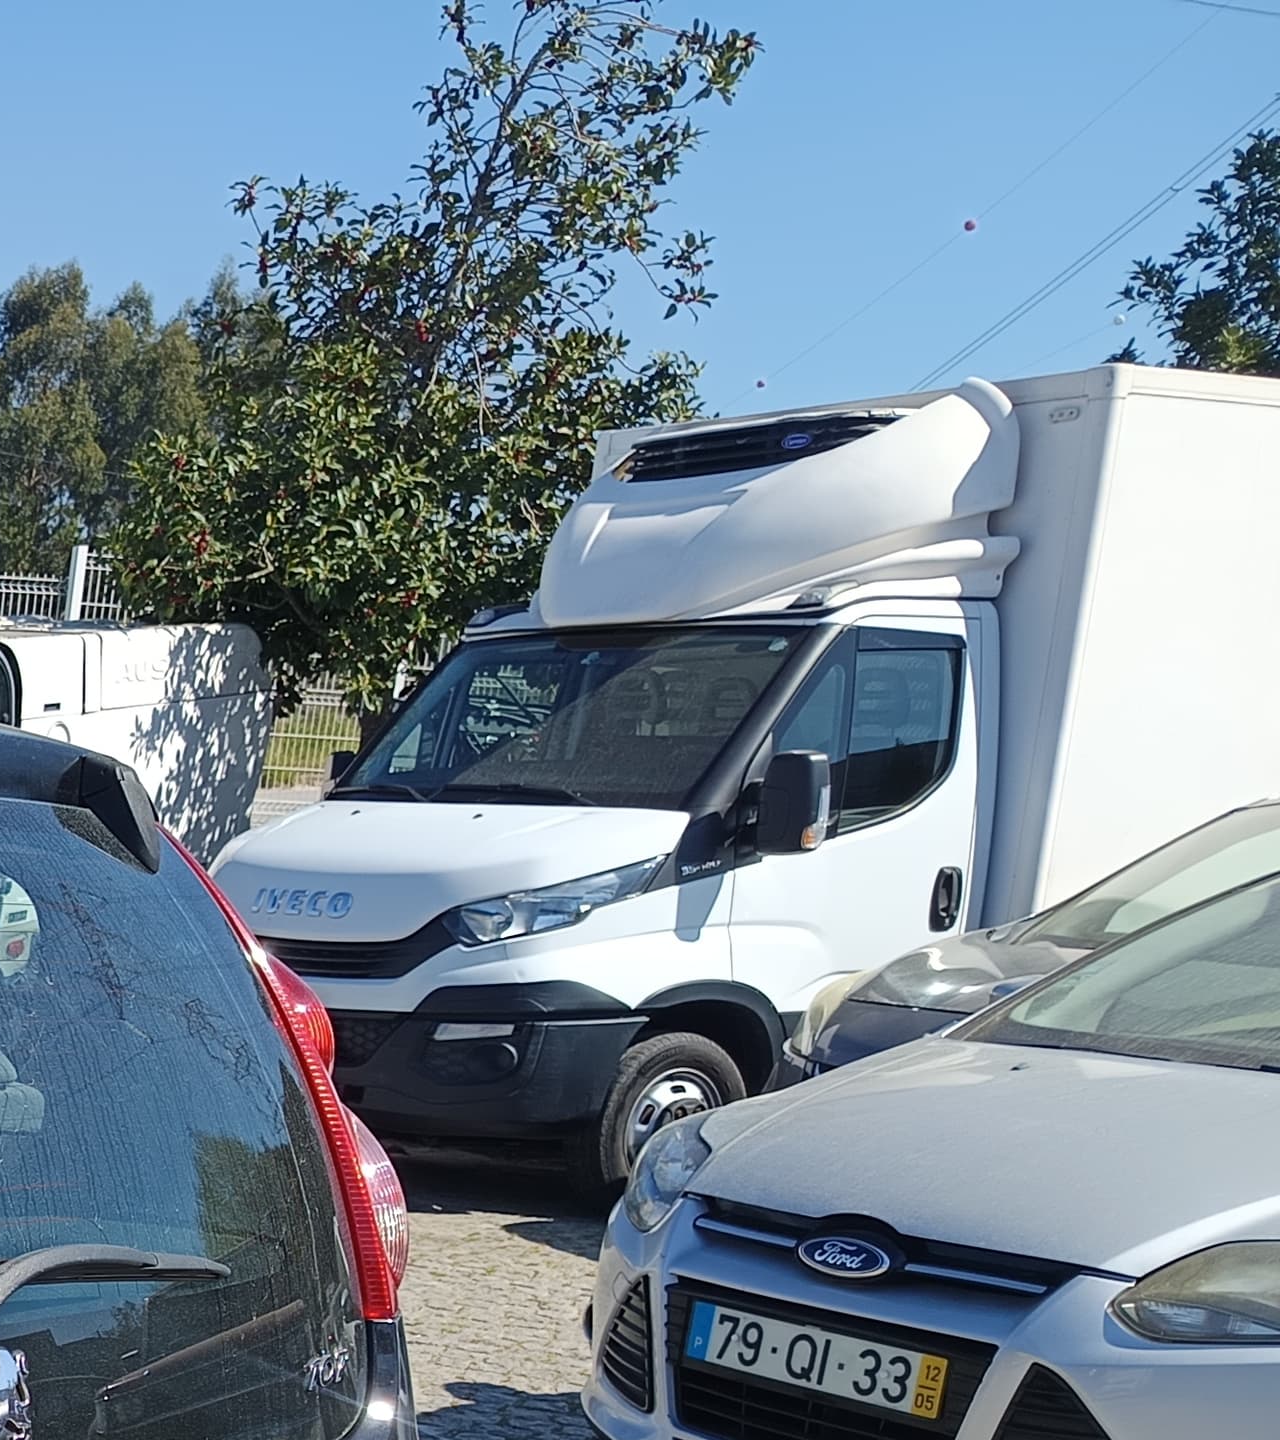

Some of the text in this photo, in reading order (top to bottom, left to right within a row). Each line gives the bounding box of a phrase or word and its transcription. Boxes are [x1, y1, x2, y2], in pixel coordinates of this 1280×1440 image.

[251, 888, 353, 919] IVECO
[814, 1241, 867, 1269] Ford
[924, 1364, 942, 1382] 12
[914, 1392, 935, 1411] 05
